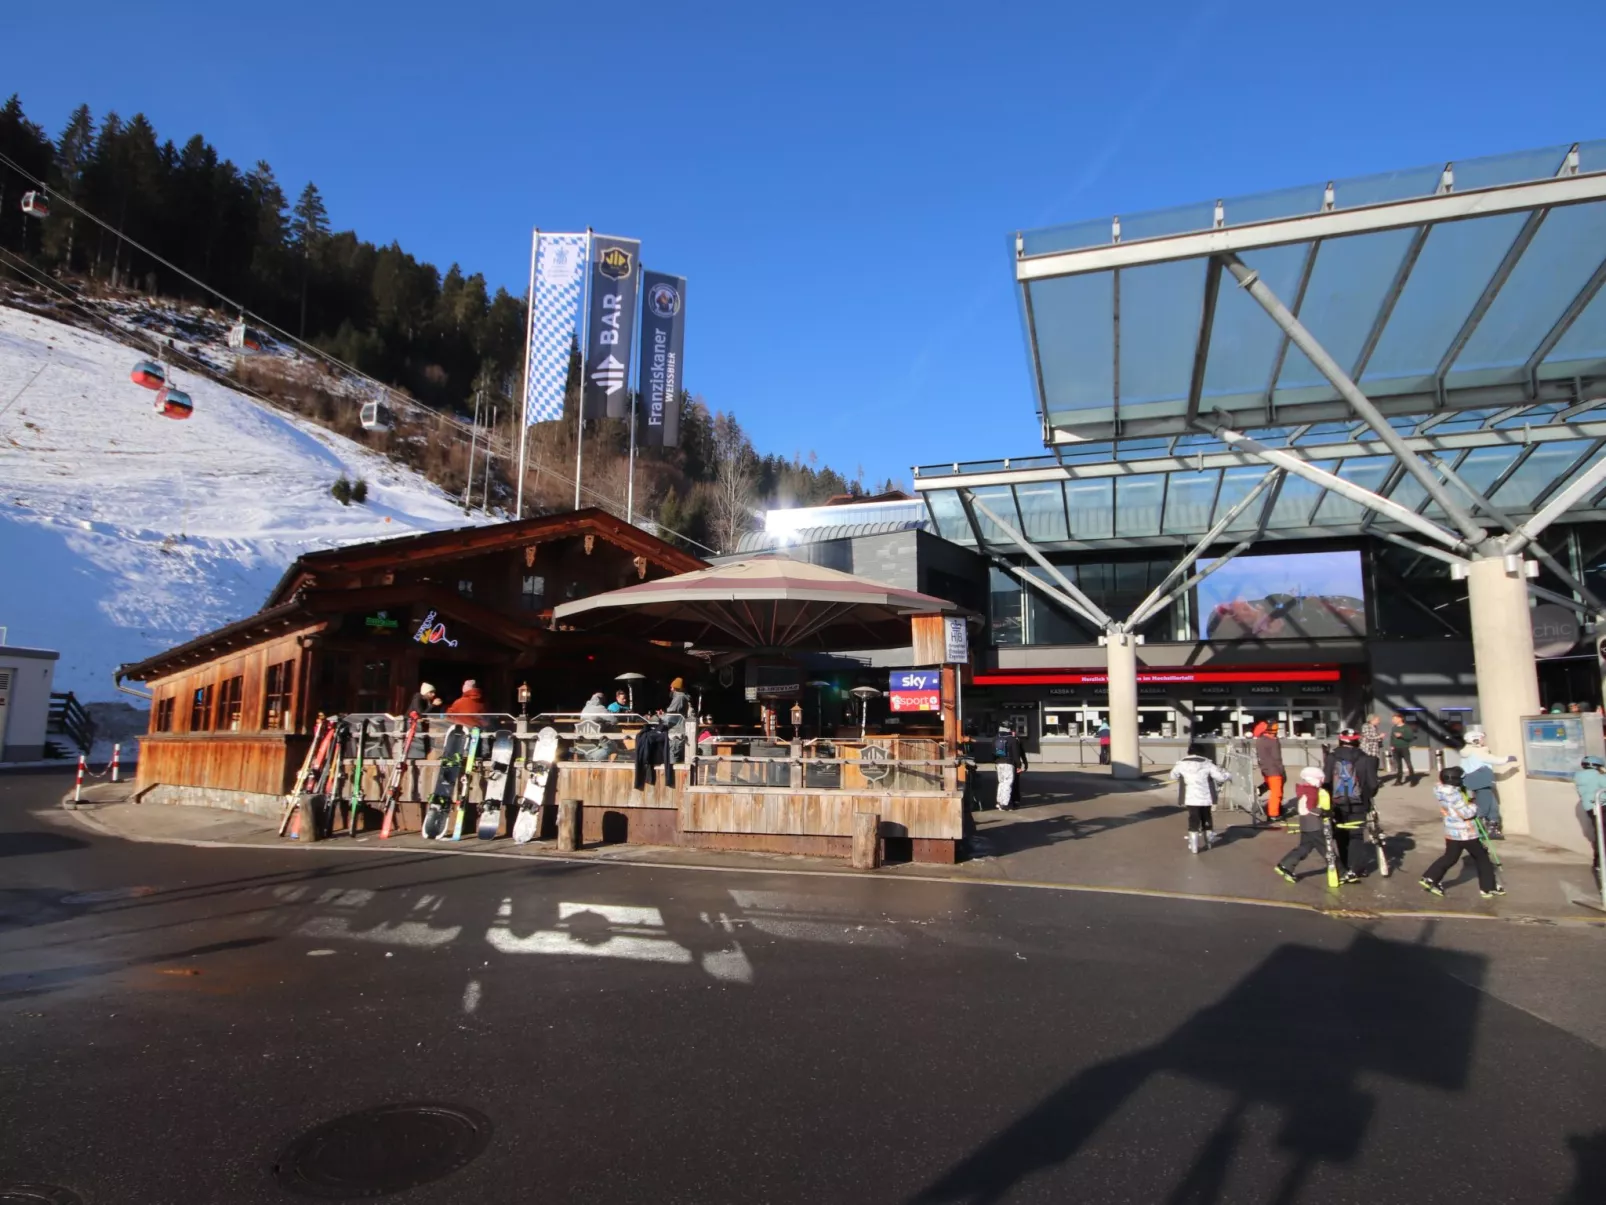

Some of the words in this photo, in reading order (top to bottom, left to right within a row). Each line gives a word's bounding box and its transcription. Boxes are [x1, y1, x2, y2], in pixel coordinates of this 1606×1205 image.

[600, 294, 623, 345] BAR
[648, 327, 667, 426] Franziskaner
[664, 352, 676, 402] WEISSBIER
[902, 674, 926, 689] sky
